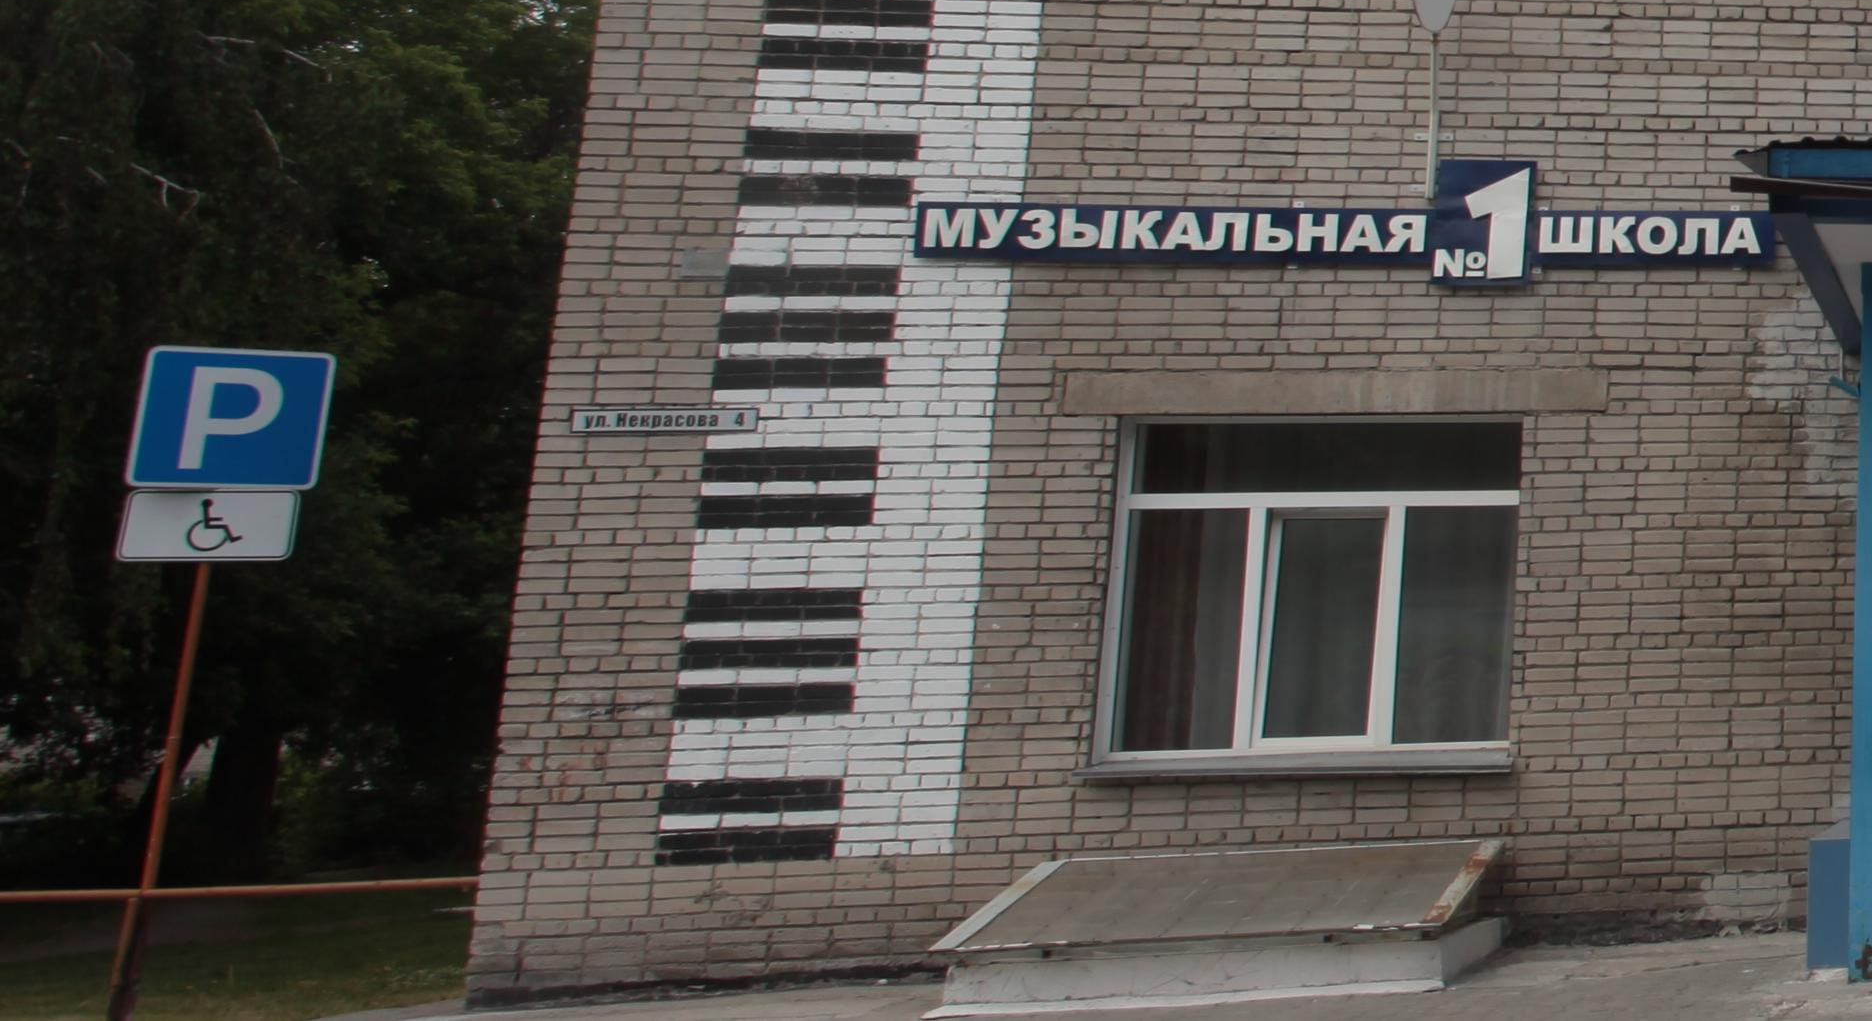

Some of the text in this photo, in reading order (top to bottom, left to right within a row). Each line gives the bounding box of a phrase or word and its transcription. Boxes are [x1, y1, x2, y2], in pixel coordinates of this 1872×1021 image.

[922, 208, 1427, 253] МУЗЫКАЛЬНАЯ
[1538, 216, 1762, 255] ШКОЛА
[177, 366, 284, 469] P
[583, 411, 746, 429] ул. Некрасова 4
